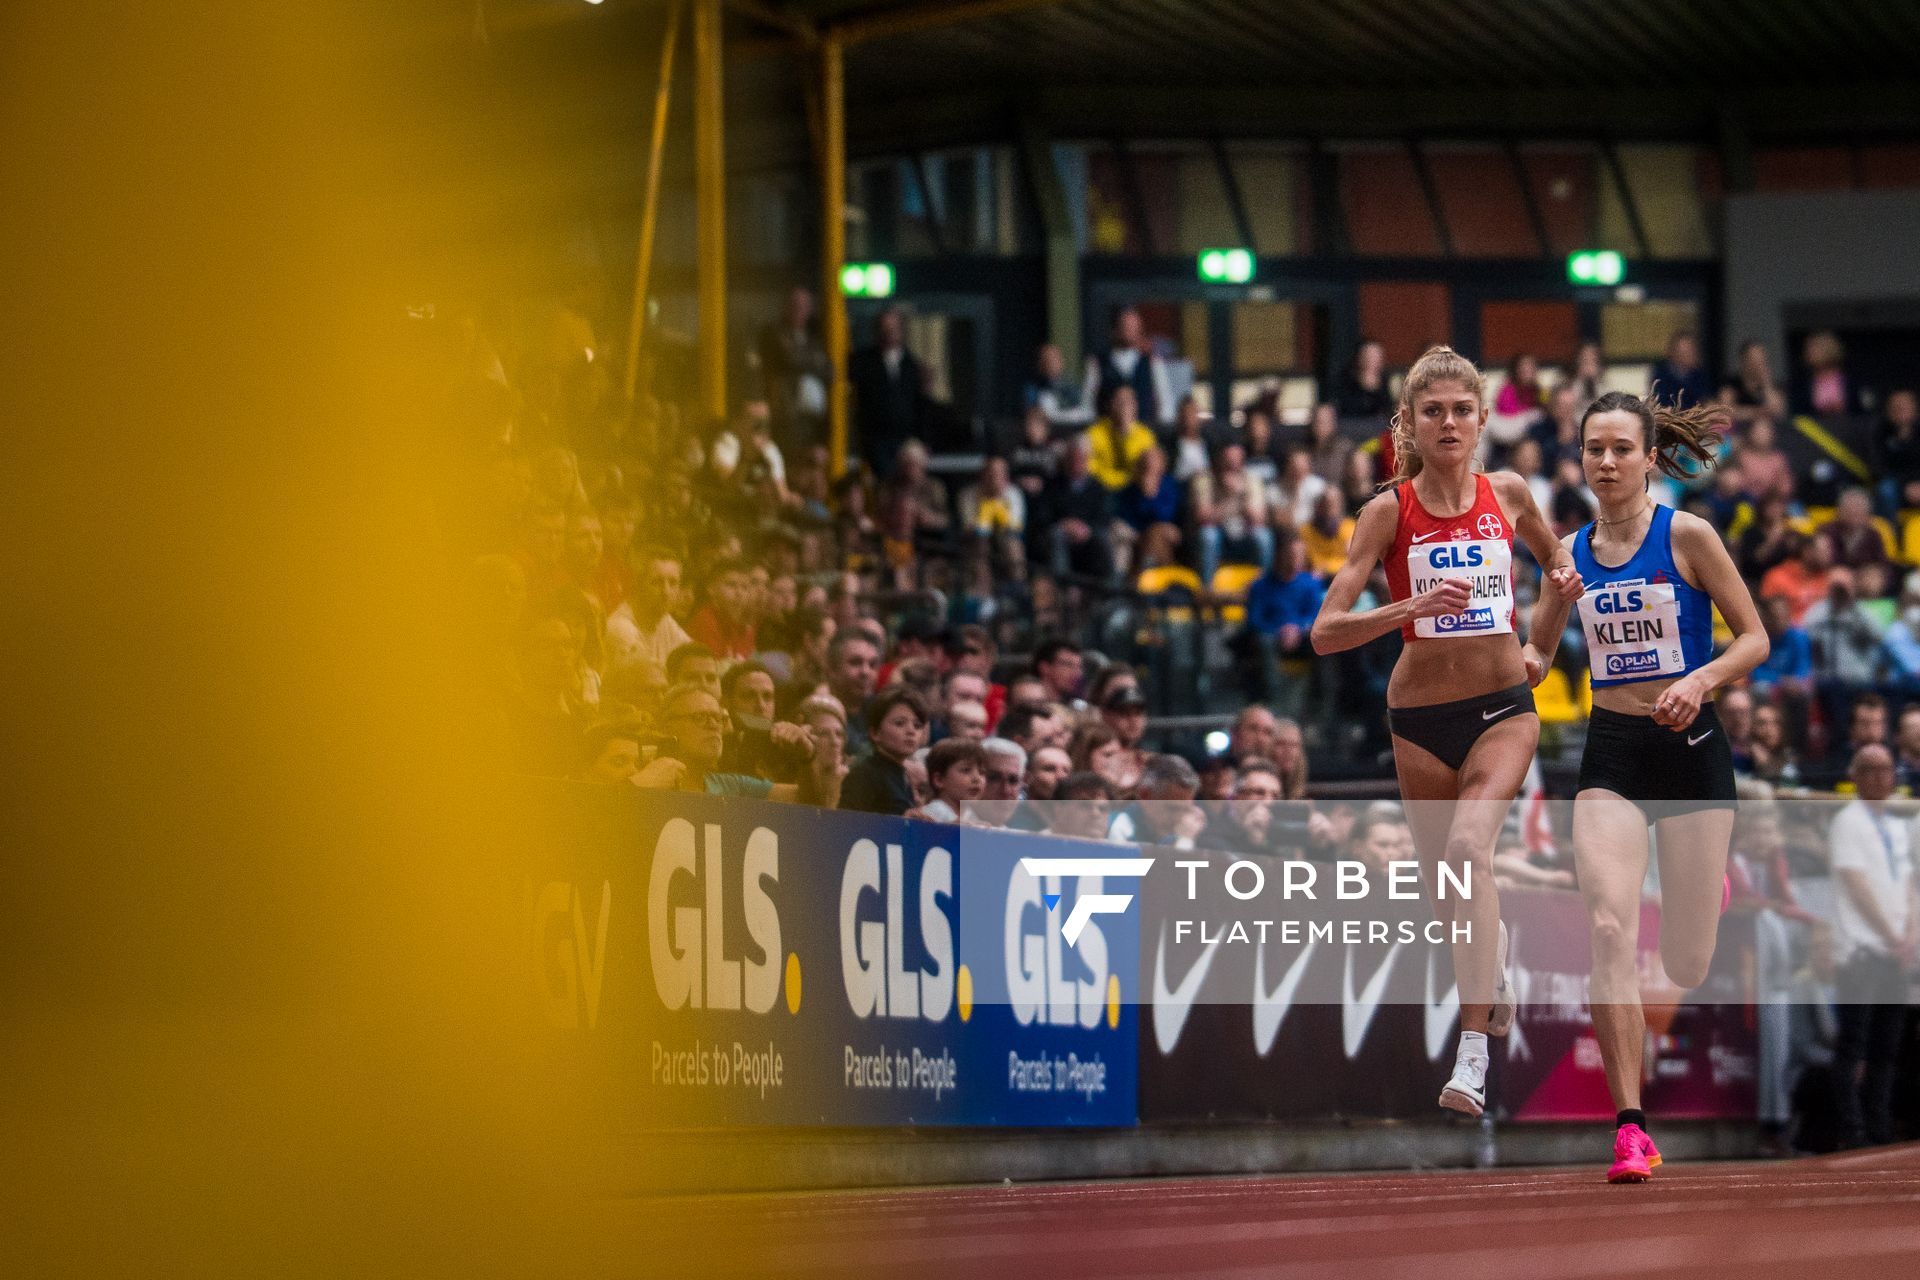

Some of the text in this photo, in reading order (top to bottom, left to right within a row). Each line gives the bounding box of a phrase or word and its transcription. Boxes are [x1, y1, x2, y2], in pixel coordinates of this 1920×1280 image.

[1460, 612, 1492, 623] PLAN
[1594, 618, 1663, 645] KLEIN
[1625, 654, 1657, 667] PLAN
[1671, 649, 1680, 663] 453
[652, 1040, 783, 1100] Parcels to People
[844, 1045, 957, 1101] Parcels to People
[1008, 1050, 1106, 1103] Parcels to People
